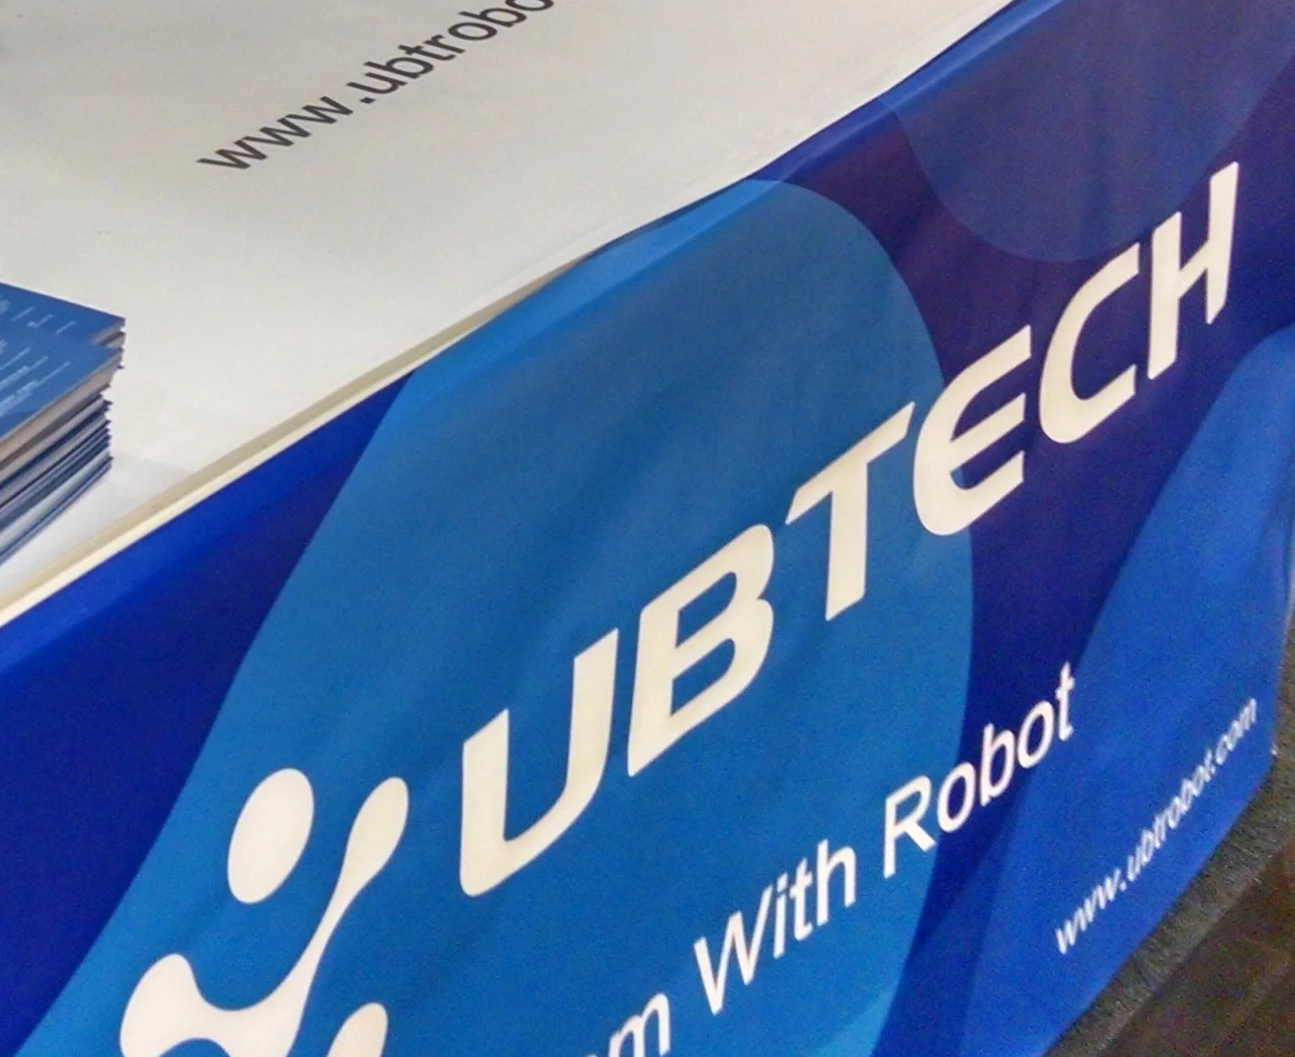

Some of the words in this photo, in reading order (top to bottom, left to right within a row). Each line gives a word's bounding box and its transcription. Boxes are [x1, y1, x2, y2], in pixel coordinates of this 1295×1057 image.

[459, 161, 1240, 897] UBTECH
[693, 839, 857, 1016] With
[883, 661, 1075, 879] Robot
[1056, 698, 1257, 956] www.ubtrobot.com
